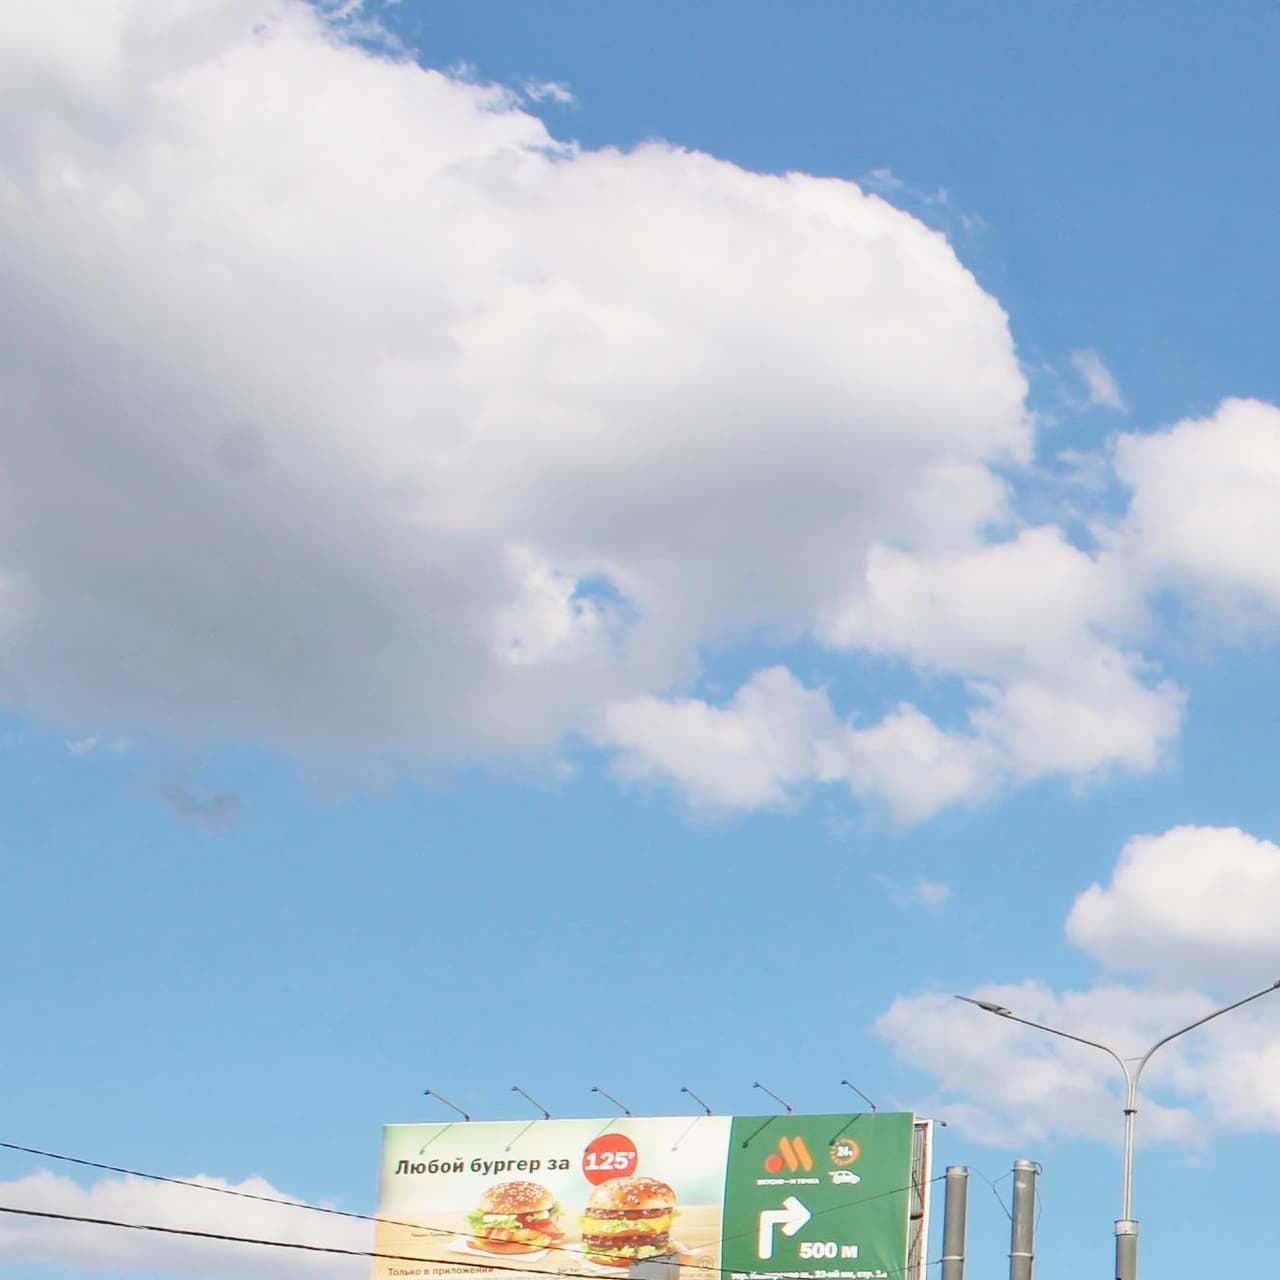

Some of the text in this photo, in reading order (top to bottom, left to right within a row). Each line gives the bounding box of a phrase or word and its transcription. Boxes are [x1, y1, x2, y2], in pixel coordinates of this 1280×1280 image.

[395, 1157, 570, 1176] Любой бургер за
[800, 1242, 858, 1259] 500 м
[388, 1267, 422, 1277] Только
